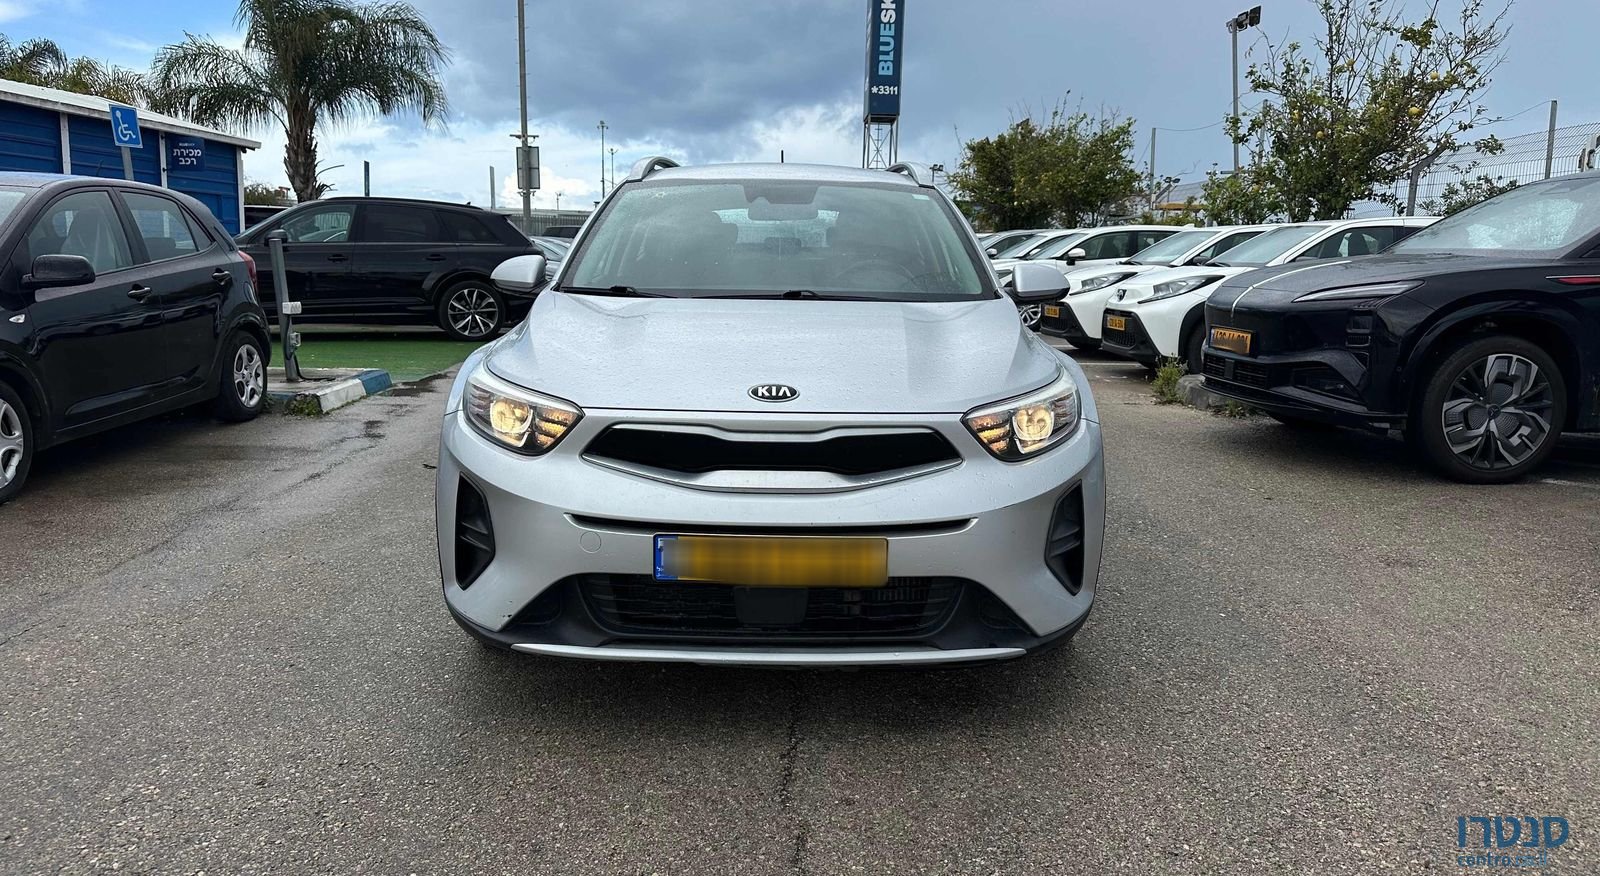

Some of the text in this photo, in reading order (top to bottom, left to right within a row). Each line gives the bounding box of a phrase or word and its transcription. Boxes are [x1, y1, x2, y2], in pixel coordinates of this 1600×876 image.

[173, 148, 202, 157] מכירת
[179, 157, 197, 165] רכב
[757, 385, 792, 397] KIA
